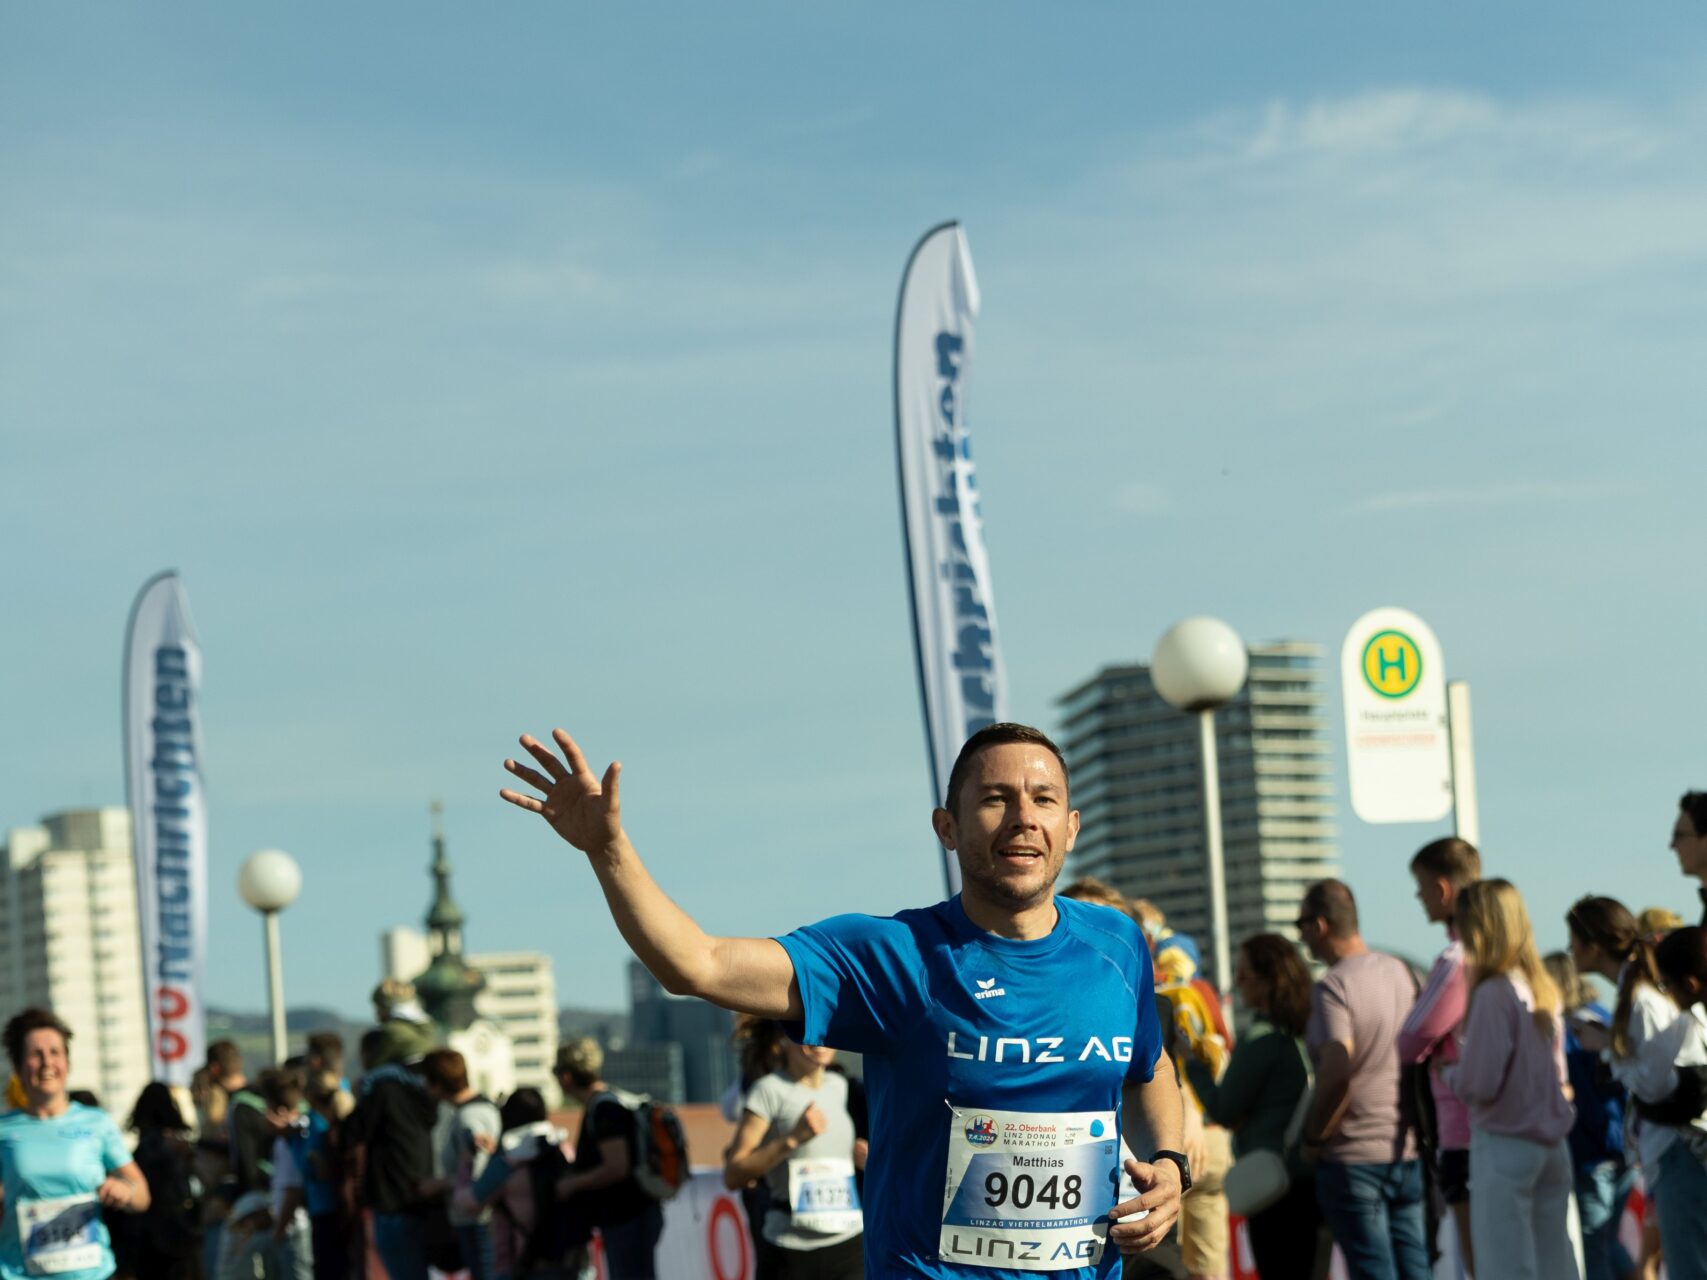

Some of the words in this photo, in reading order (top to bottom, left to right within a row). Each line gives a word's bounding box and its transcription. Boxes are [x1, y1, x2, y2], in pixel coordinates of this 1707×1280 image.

[1378, 647, 1406, 682] H
[974, 987, 1006, 1000] erima
[947, 1031, 1065, 1063] LINZ
[1078, 1036, 1133, 1063] AG
[1004, 1123, 1018, 1131] 22.
[1018, 1123, 1057, 1133] Oberbank
[1003, 1131, 1024, 1139] LINZ
[1026, 1133, 1057, 1141] DONAU
[1003, 1139, 1057, 1148] MARATHON
[1012, 1155, 1065, 1169] Matthias
[984, 1172, 1082, 1210] 9048
[1007, 1217, 1089, 1228] VIERTELMARATHON
[951, 1233, 1042, 1261] LINZ
